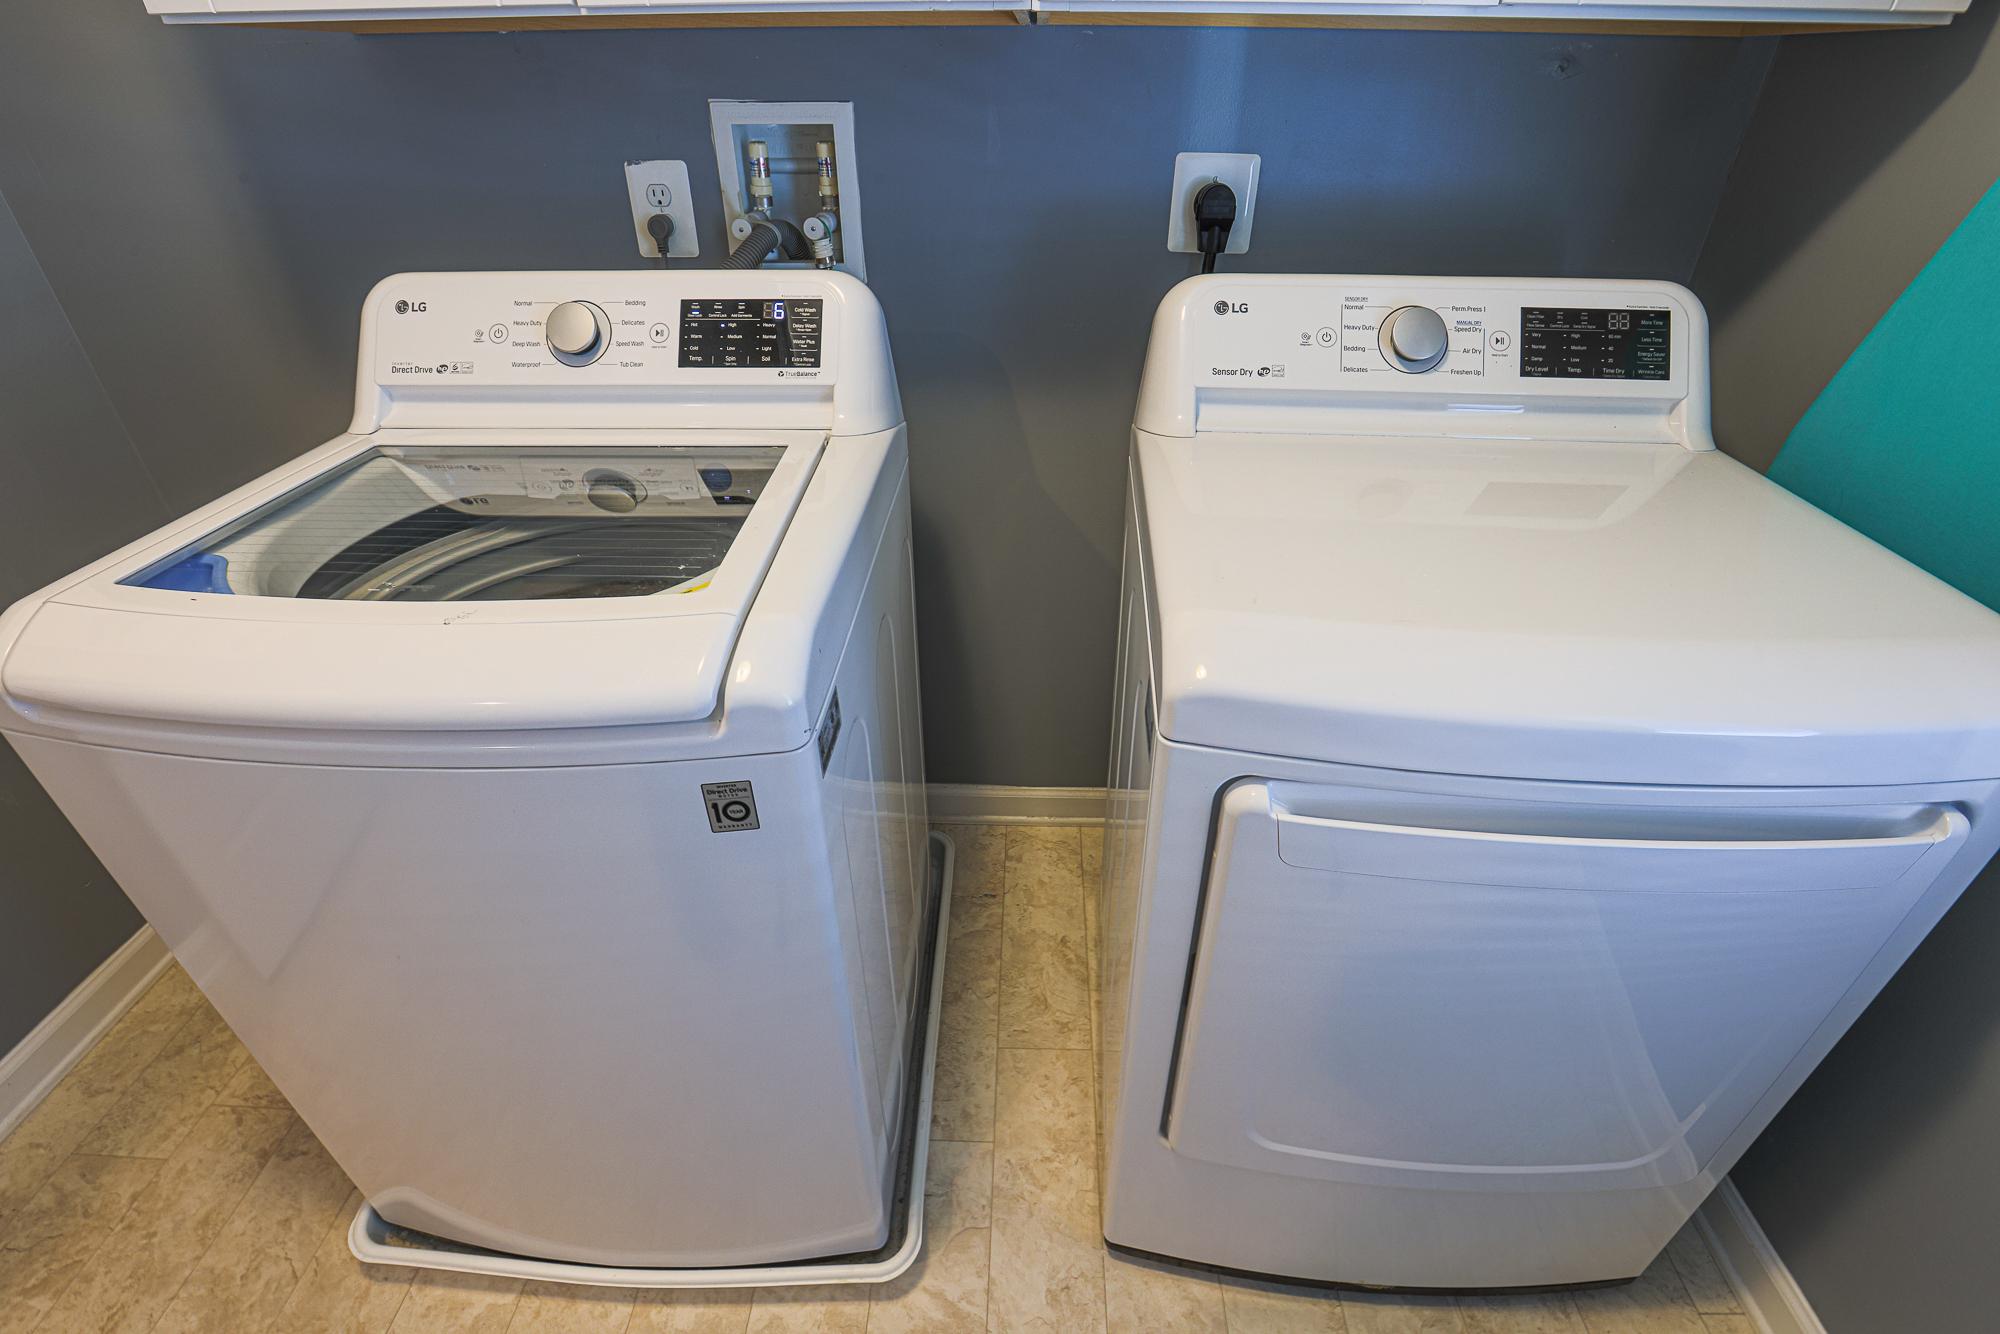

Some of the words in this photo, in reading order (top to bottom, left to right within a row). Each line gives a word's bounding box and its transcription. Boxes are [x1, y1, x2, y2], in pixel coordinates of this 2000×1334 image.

[411, 302, 427, 312] LG
[1231, 303, 1249, 313] LG
[1240, 368, 1253, 377] Dry
[711, 801, 751, 823] 10
